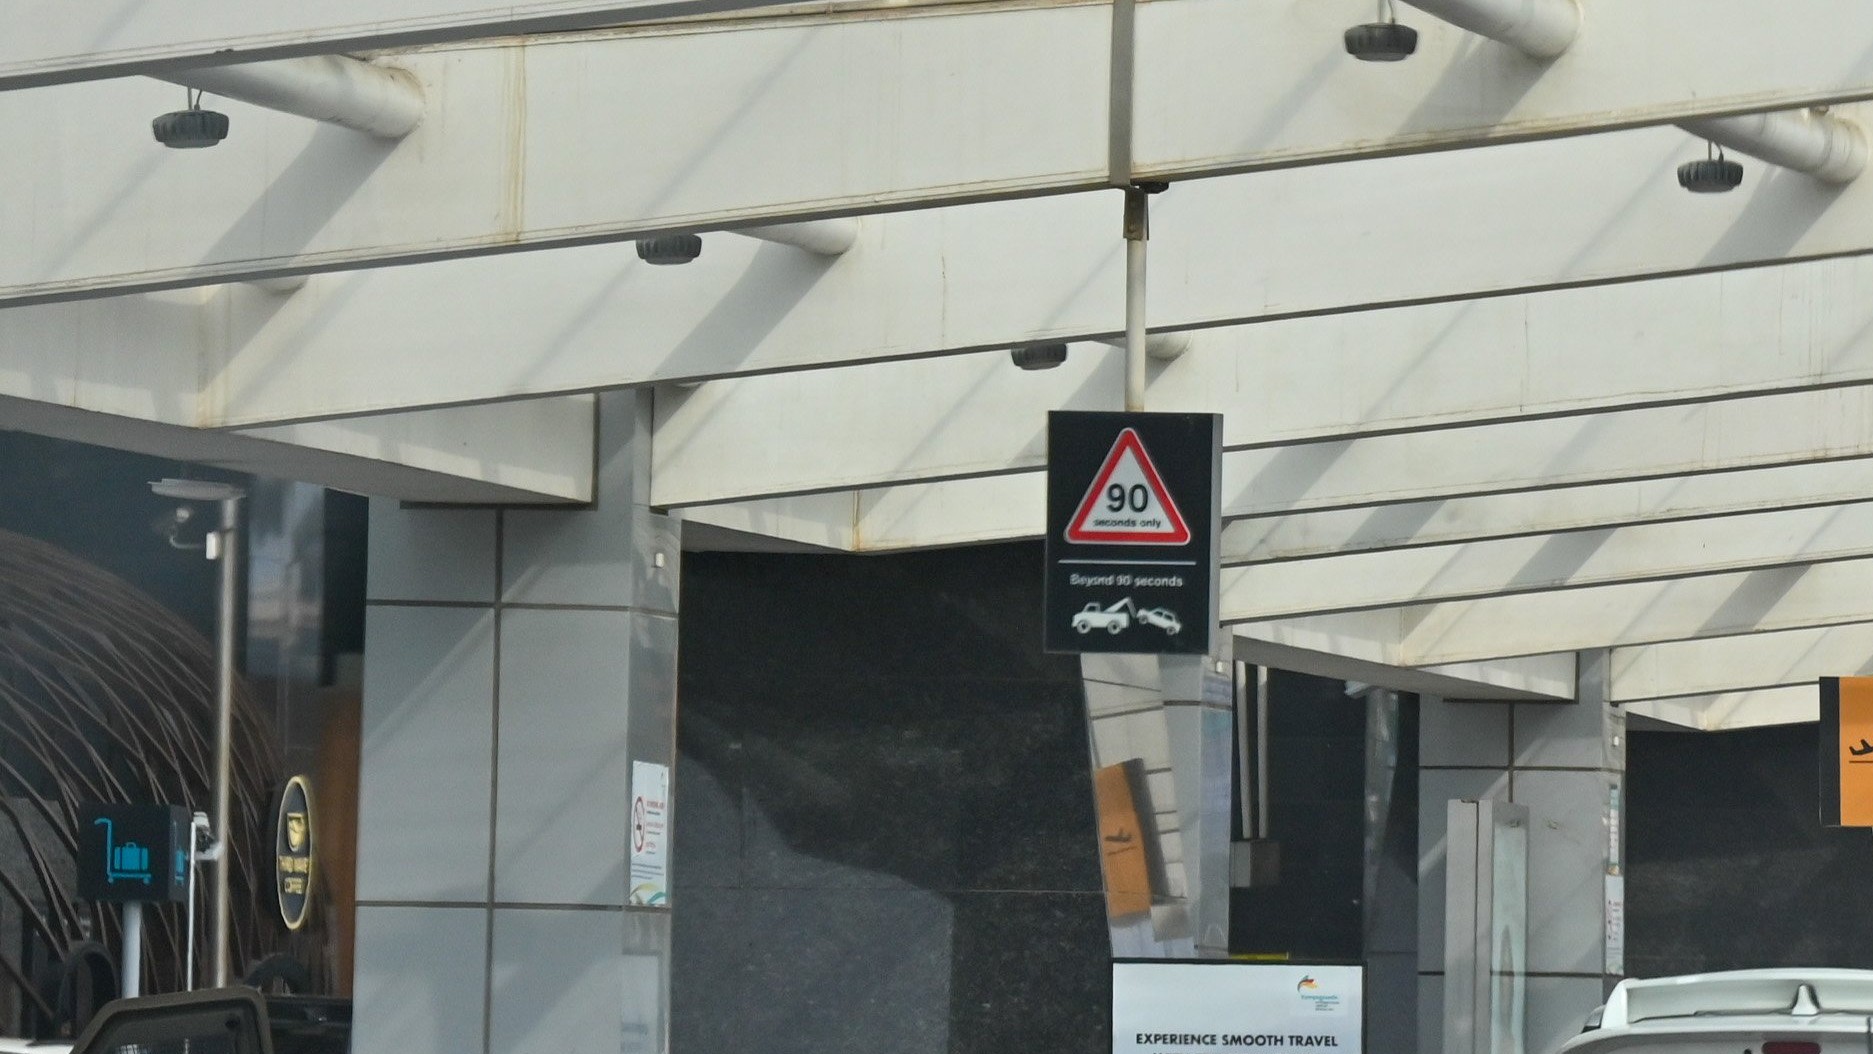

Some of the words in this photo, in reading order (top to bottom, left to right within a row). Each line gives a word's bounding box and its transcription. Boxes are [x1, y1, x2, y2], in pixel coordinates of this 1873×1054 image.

[1107, 483, 1148, 513] 90
[1093, 518, 1137, 528] seconds
[1140, 518, 1161, 529] only
[1069, 573, 1114, 587] Beyond
[1116, 574, 1131, 586] 90
[1133, 575, 1183, 588] seconds
[1136, 1033, 1217, 1045] EXPERIENCE
[1222, 1034, 1284, 1046] SMOOTH
[1288, 1035, 1338, 1047] TRAVEL
